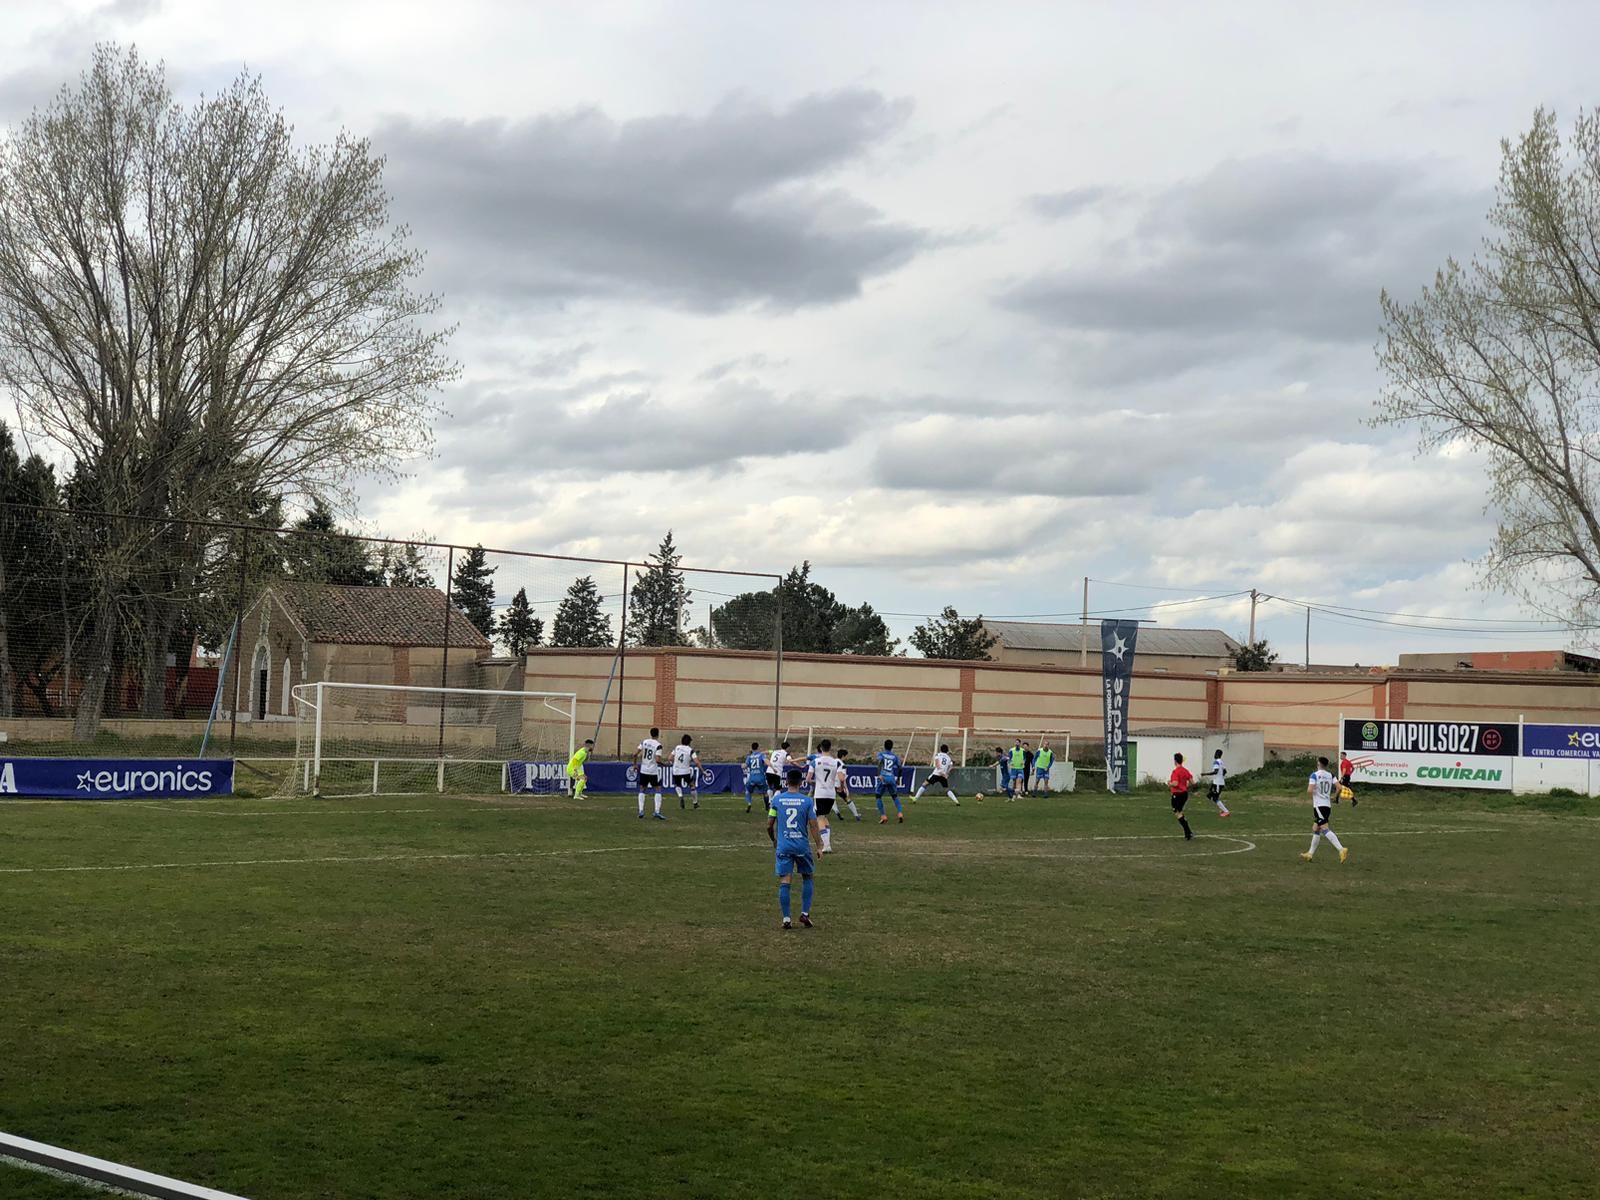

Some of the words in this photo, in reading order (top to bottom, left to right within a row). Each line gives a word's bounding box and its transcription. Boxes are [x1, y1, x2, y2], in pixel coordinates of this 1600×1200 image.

[1112, 678, 1125, 783] aspasia
[1383, 723, 1479, 752] IMPULSO27
[643, 748, 653, 760] 18
[677, 753, 685, 763] 4
[772, 753, 780, 763] 5
[1531, 748, 1555, 756] CENTRO
[1556, 749, 1591, 757] COMERCIAL
[750, 758, 760, 769] 21
[883, 758, 894, 770] 12
[941, 757, 948, 766] 8
[823, 769, 831, 782] 7
[1416, 762, 1502, 781] COVIRAN
[94, 765, 212, 792] euronics
[849, 775, 873, 788] CAJA
[1319, 780, 1330, 794] 10
[785, 807, 798, 828] 2
